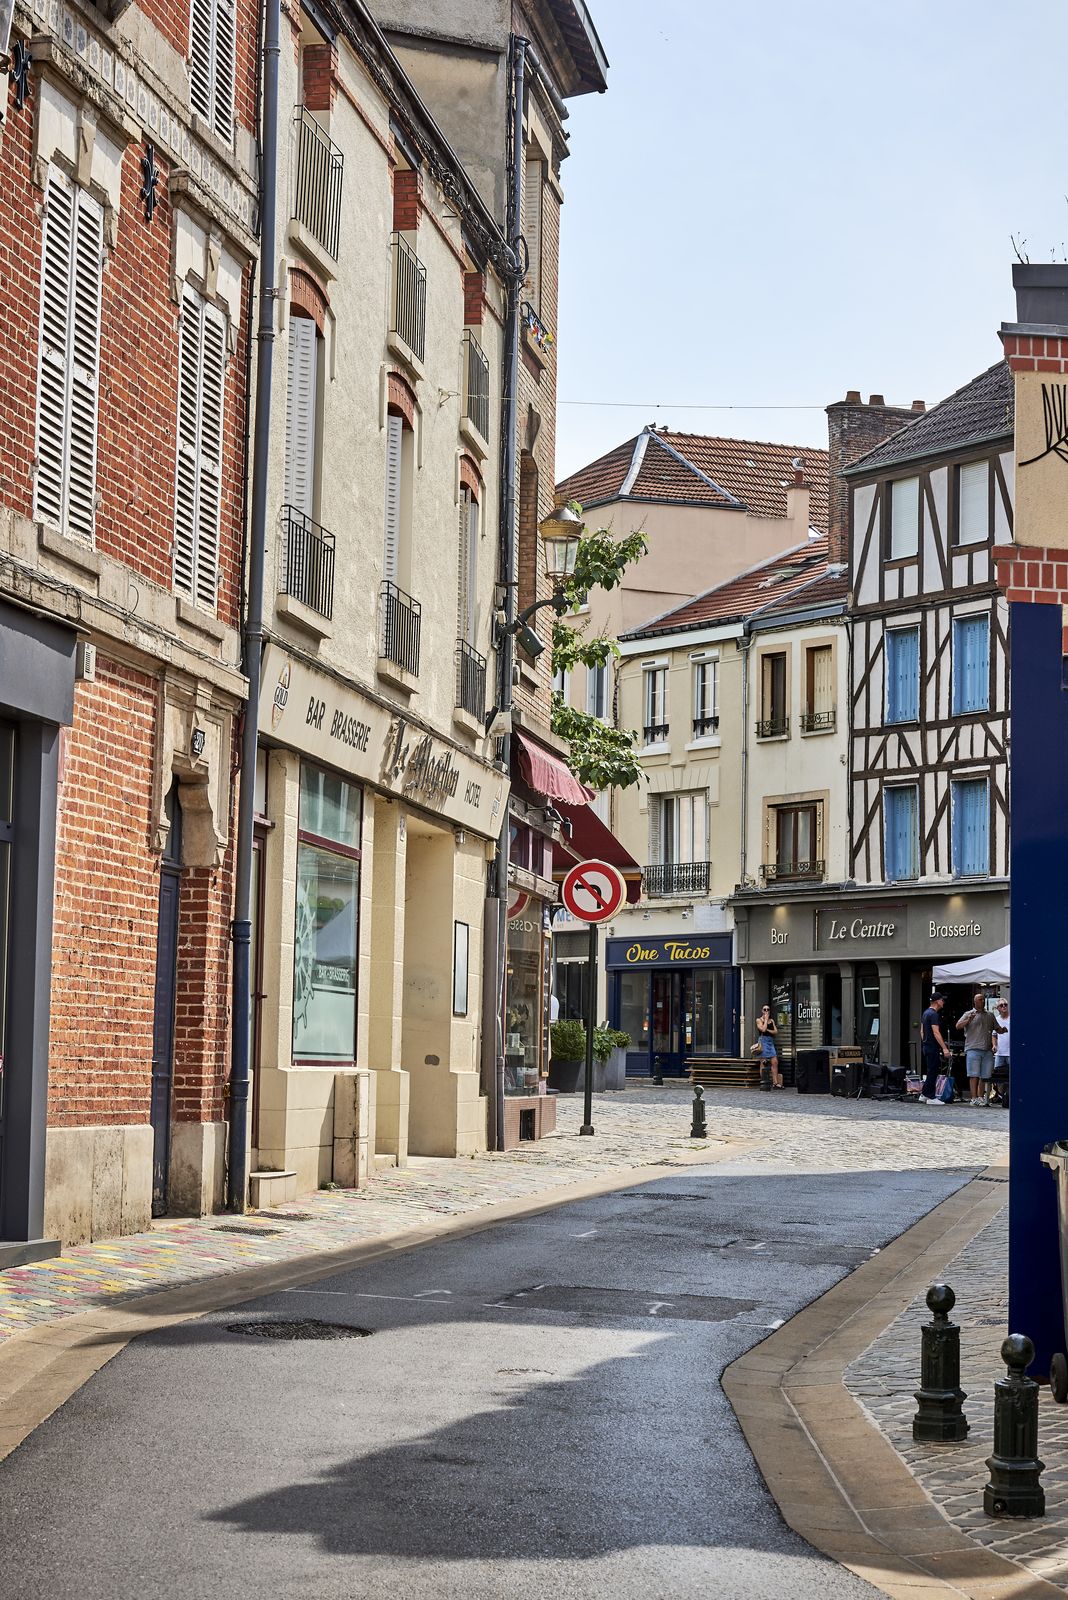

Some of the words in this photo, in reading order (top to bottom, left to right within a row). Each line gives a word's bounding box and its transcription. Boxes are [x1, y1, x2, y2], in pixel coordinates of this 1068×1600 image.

[306, 696, 326, 730] BAR
[330, 709, 371, 752] BRASSERIE
[464, 780, 481, 808] HOTEL
[771, 928, 789, 944] Bar
[828, 920, 847, 940] Le
[851, 918, 895, 939] Centre
[929, 919, 982, 938] Brasserie
[626, 943, 659, 962] One
[664, 942, 710, 961] Tacos
[798, 1003, 821, 1018] Centre
